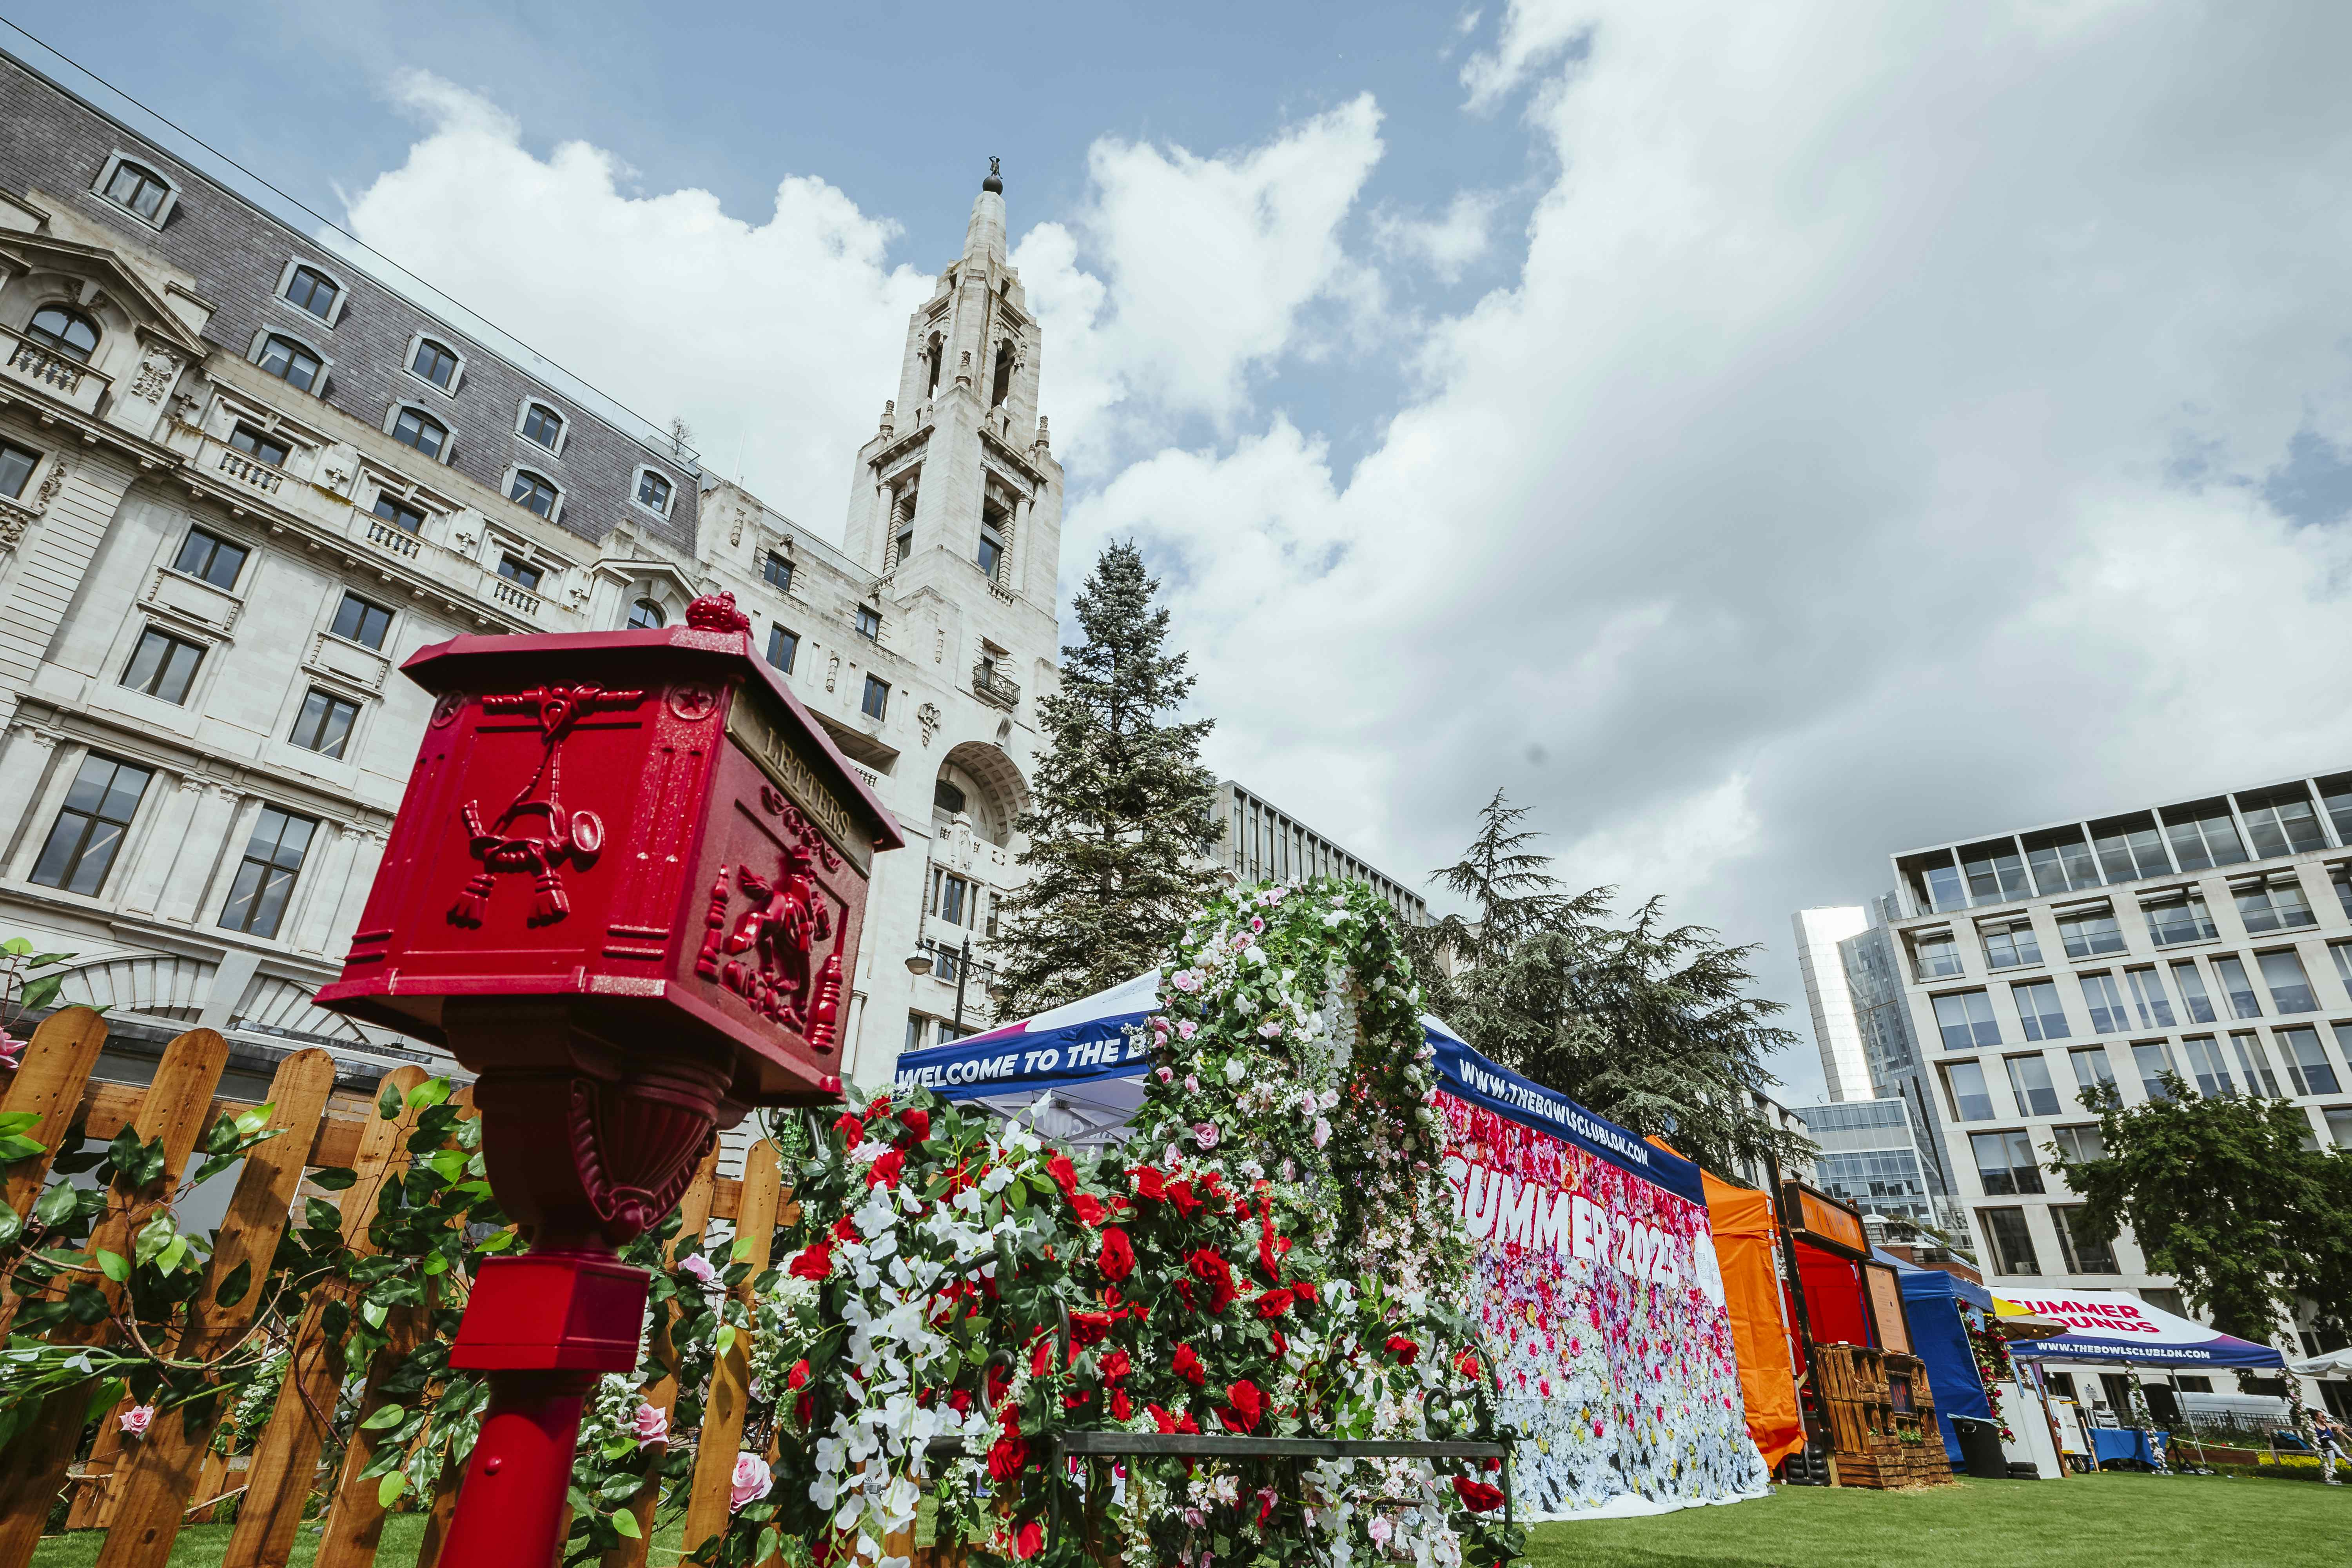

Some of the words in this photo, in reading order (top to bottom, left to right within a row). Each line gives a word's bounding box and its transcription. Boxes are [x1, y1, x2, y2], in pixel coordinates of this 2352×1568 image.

[763, 727, 850, 841] LETTERS
[898, 1054, 1019, 1088] WELCOME
[1024, 1049, 1059, 1073] TO
[1067, 1038, 1121, 1068] THE
[1459, 1058, 1649, 1167] WWW.THEBOWLSCLUBLDN.COM
[2036, 1342, 2210, 1359] WWW.THEBOWLSCLUBLDN.COM
